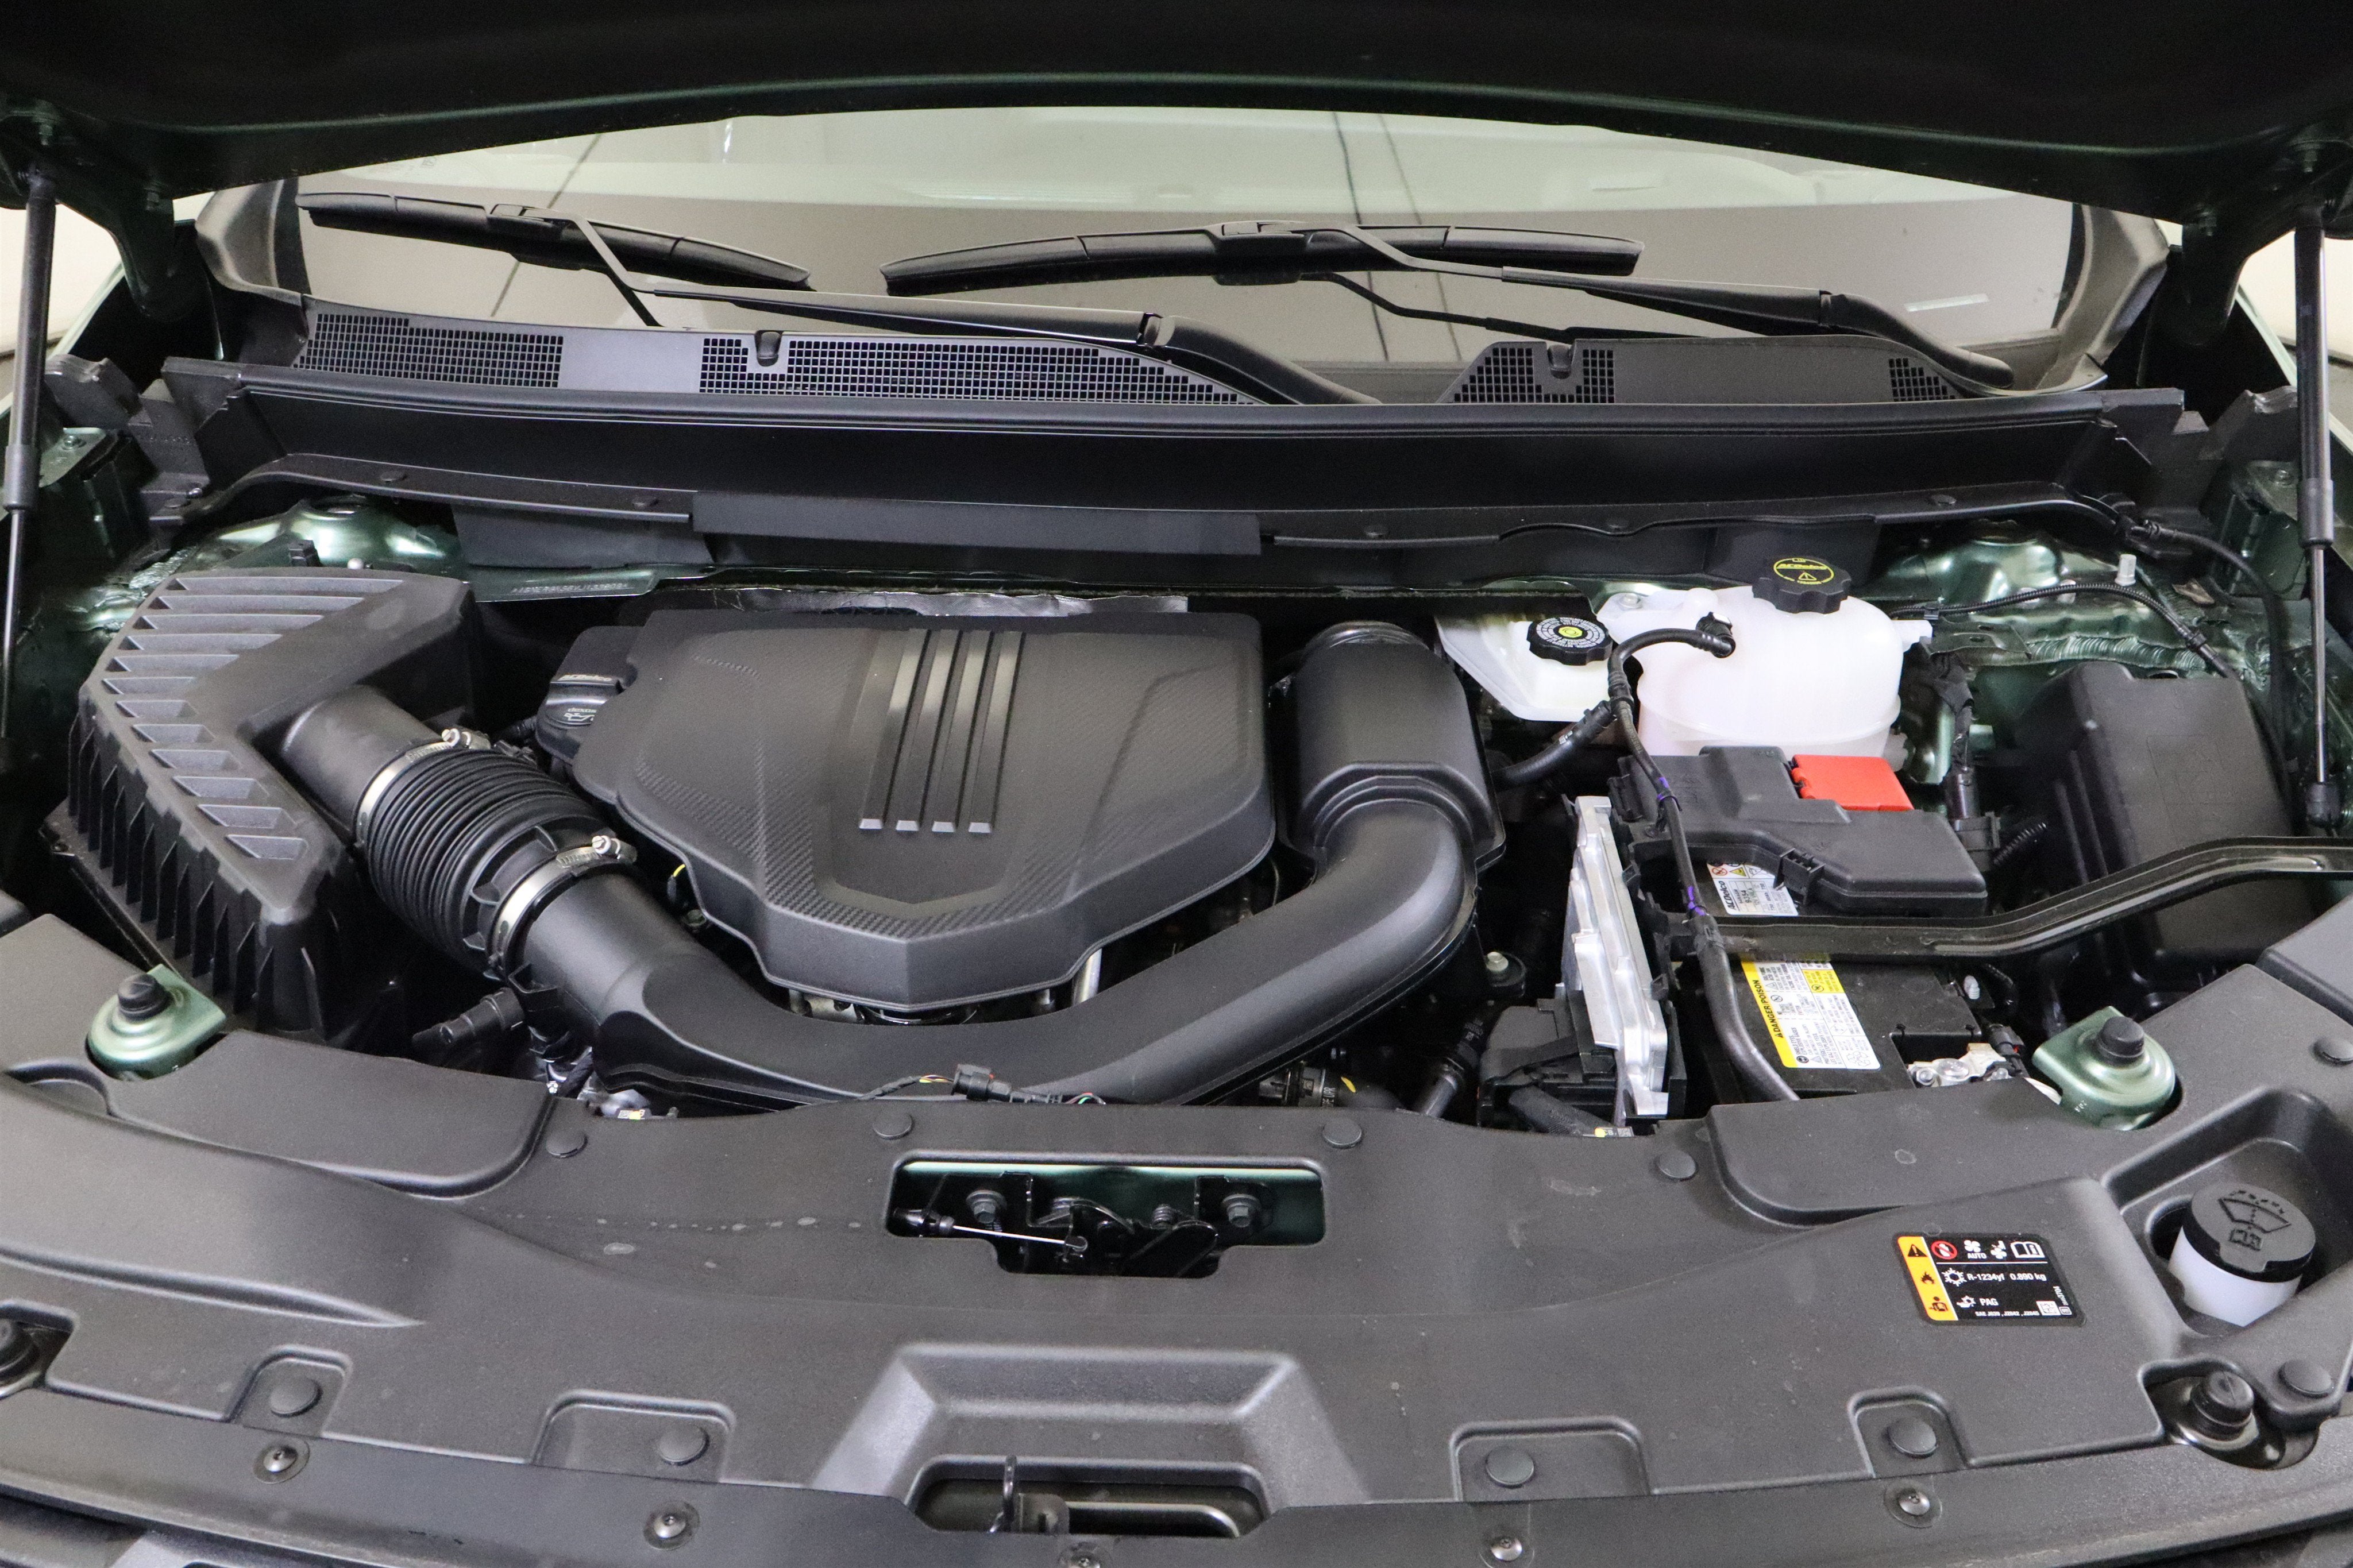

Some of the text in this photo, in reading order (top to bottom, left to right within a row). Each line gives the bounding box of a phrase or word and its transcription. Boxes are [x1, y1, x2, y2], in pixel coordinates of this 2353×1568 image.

[1718, 880, 1735, 910] ACDelco
[1966, 1272, 2047, 1283] R-1234yf 0.890 kg
[1980, 1298, 1999, 1306] PAG
